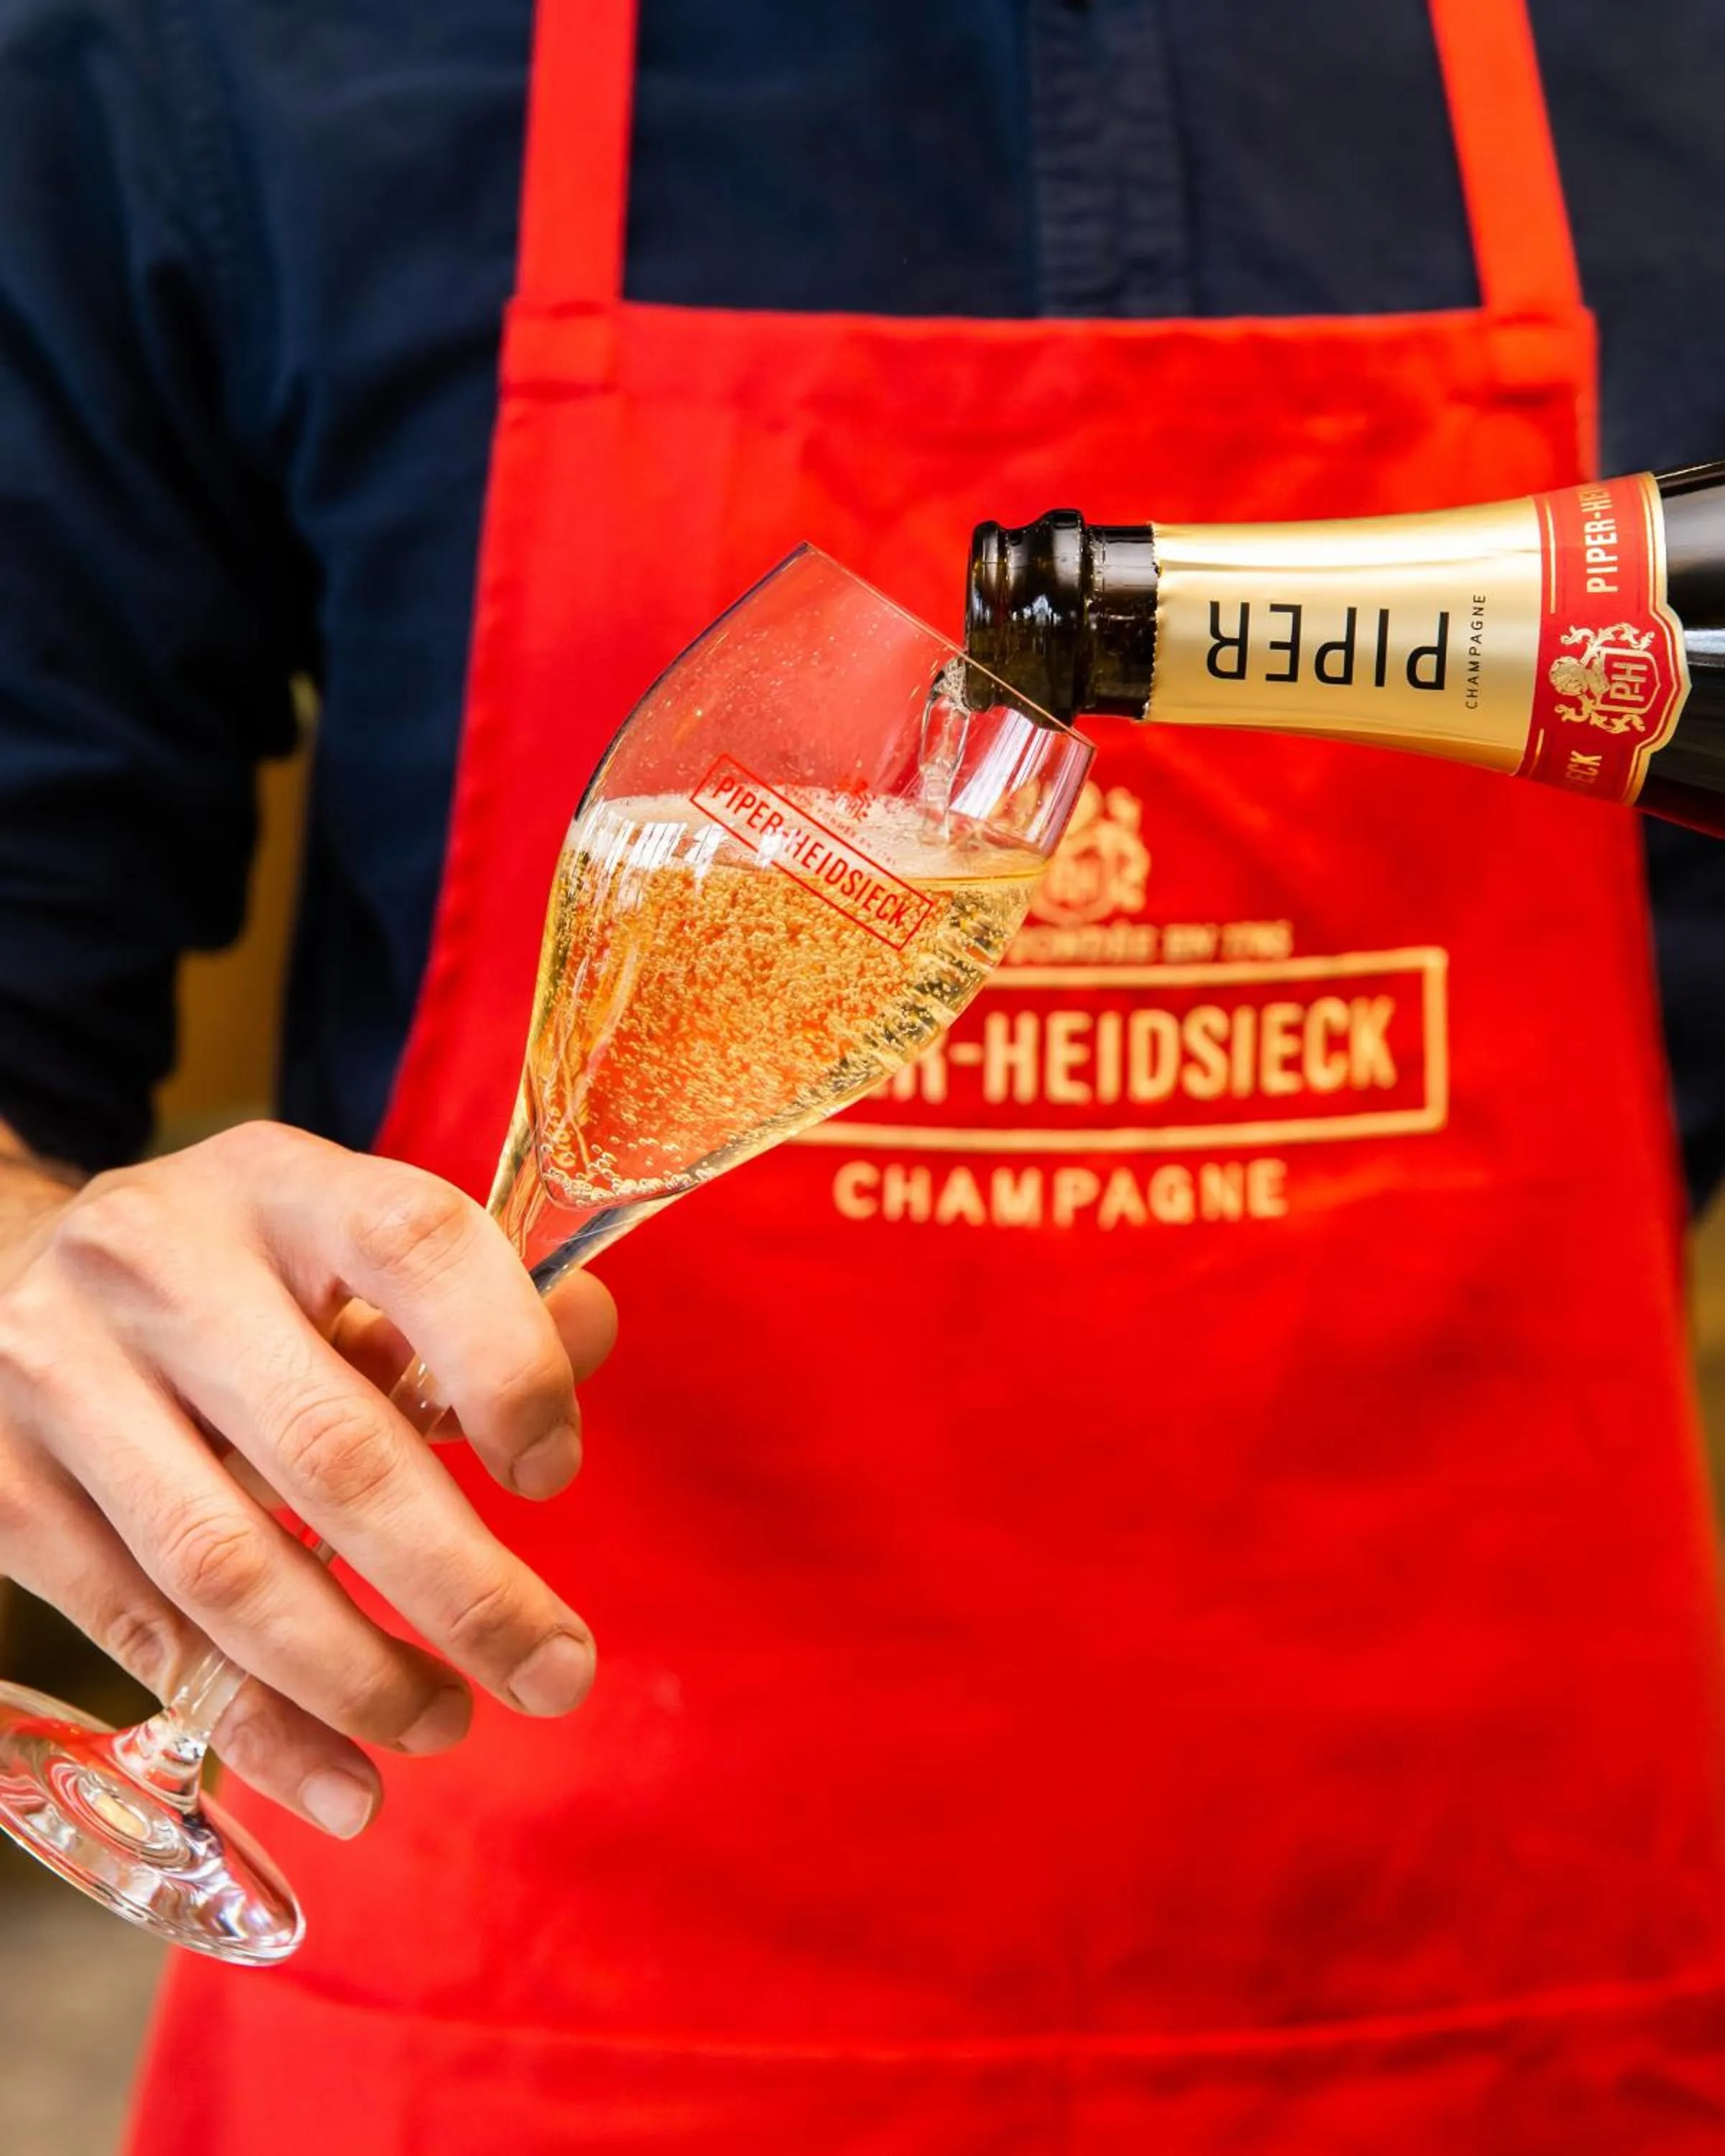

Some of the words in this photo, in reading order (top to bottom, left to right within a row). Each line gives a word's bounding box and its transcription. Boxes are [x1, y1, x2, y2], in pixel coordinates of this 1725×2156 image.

[1207, 600, 1450, 691] PIPER
[1465, 594, 1486, 710] CHAMPAGNE
[711, 776, 913, 929] PIPER-HEIDSIECK
[865, 995, 1398, 1105] R-HEIDSIECK
[832, 1158, 1289, 1230] CHAMPAGNE
